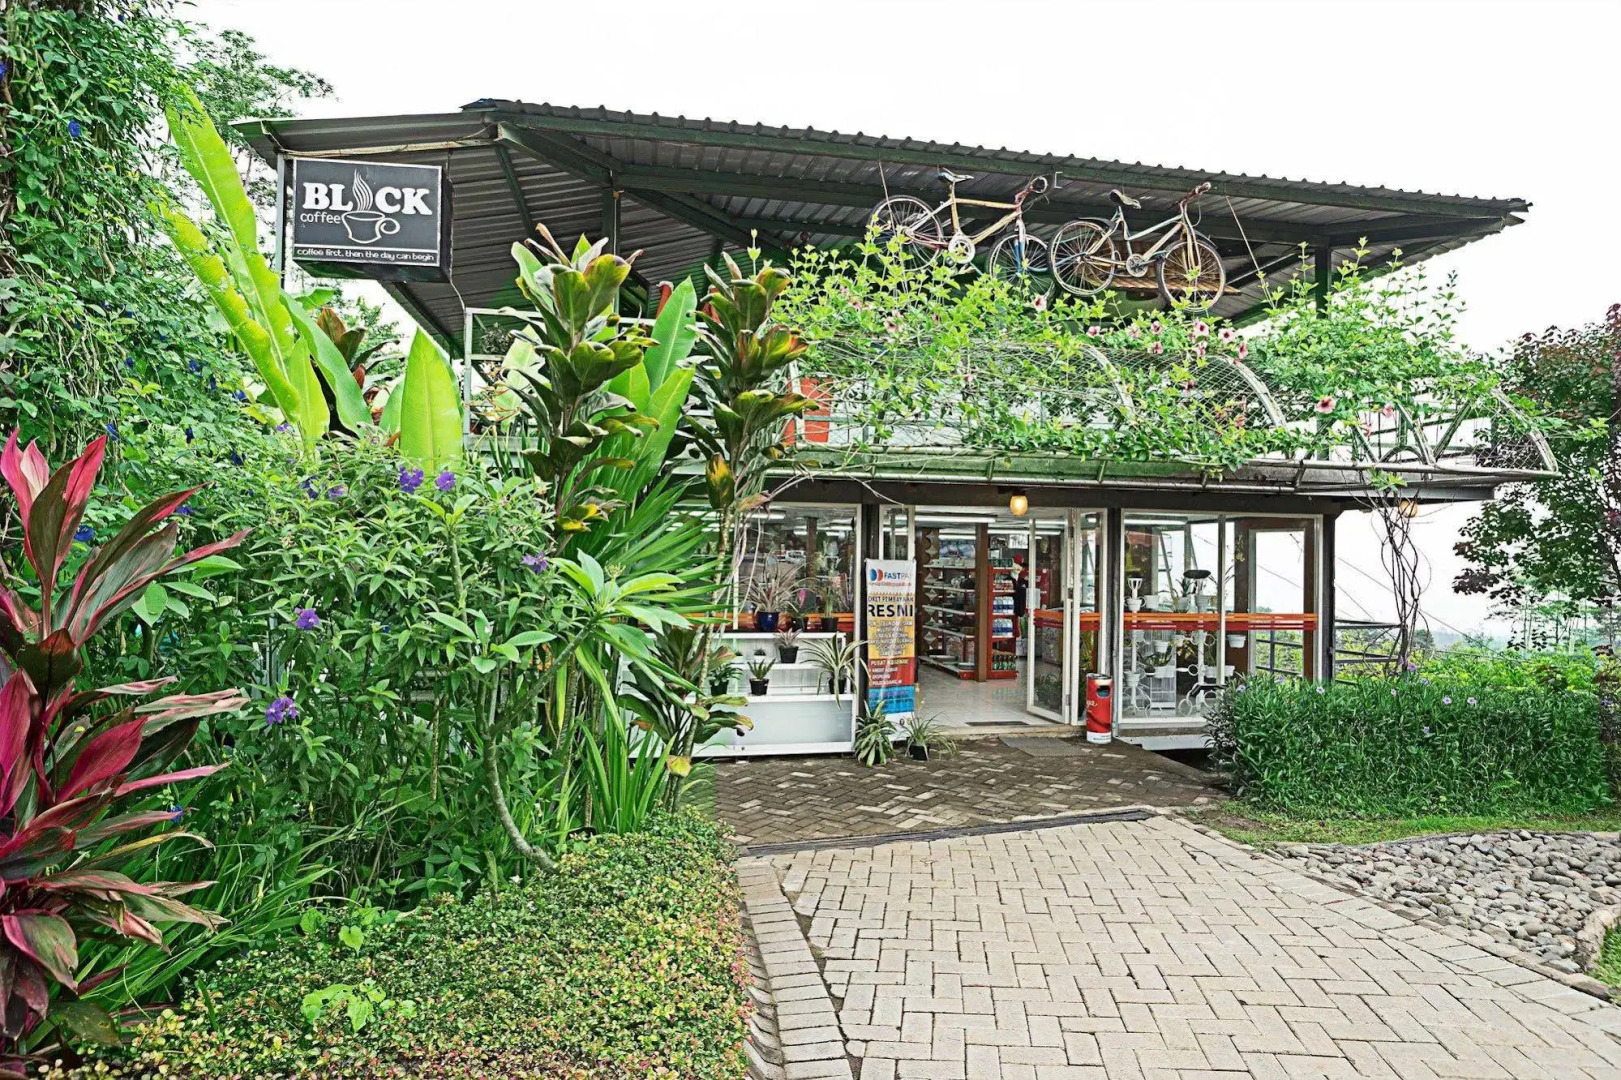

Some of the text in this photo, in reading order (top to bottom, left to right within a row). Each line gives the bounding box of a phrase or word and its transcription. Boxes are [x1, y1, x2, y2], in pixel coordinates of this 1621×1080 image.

[300, 211, 341, 224] coffee
[297, 248, 324, 256] coffee
[345, 250, 363, 258] then
[365, 250, 379, 258] the
[380, 251, 395, 261] day
[396, 252, 411, 260] can
[412, 252, 435, 261] begin
